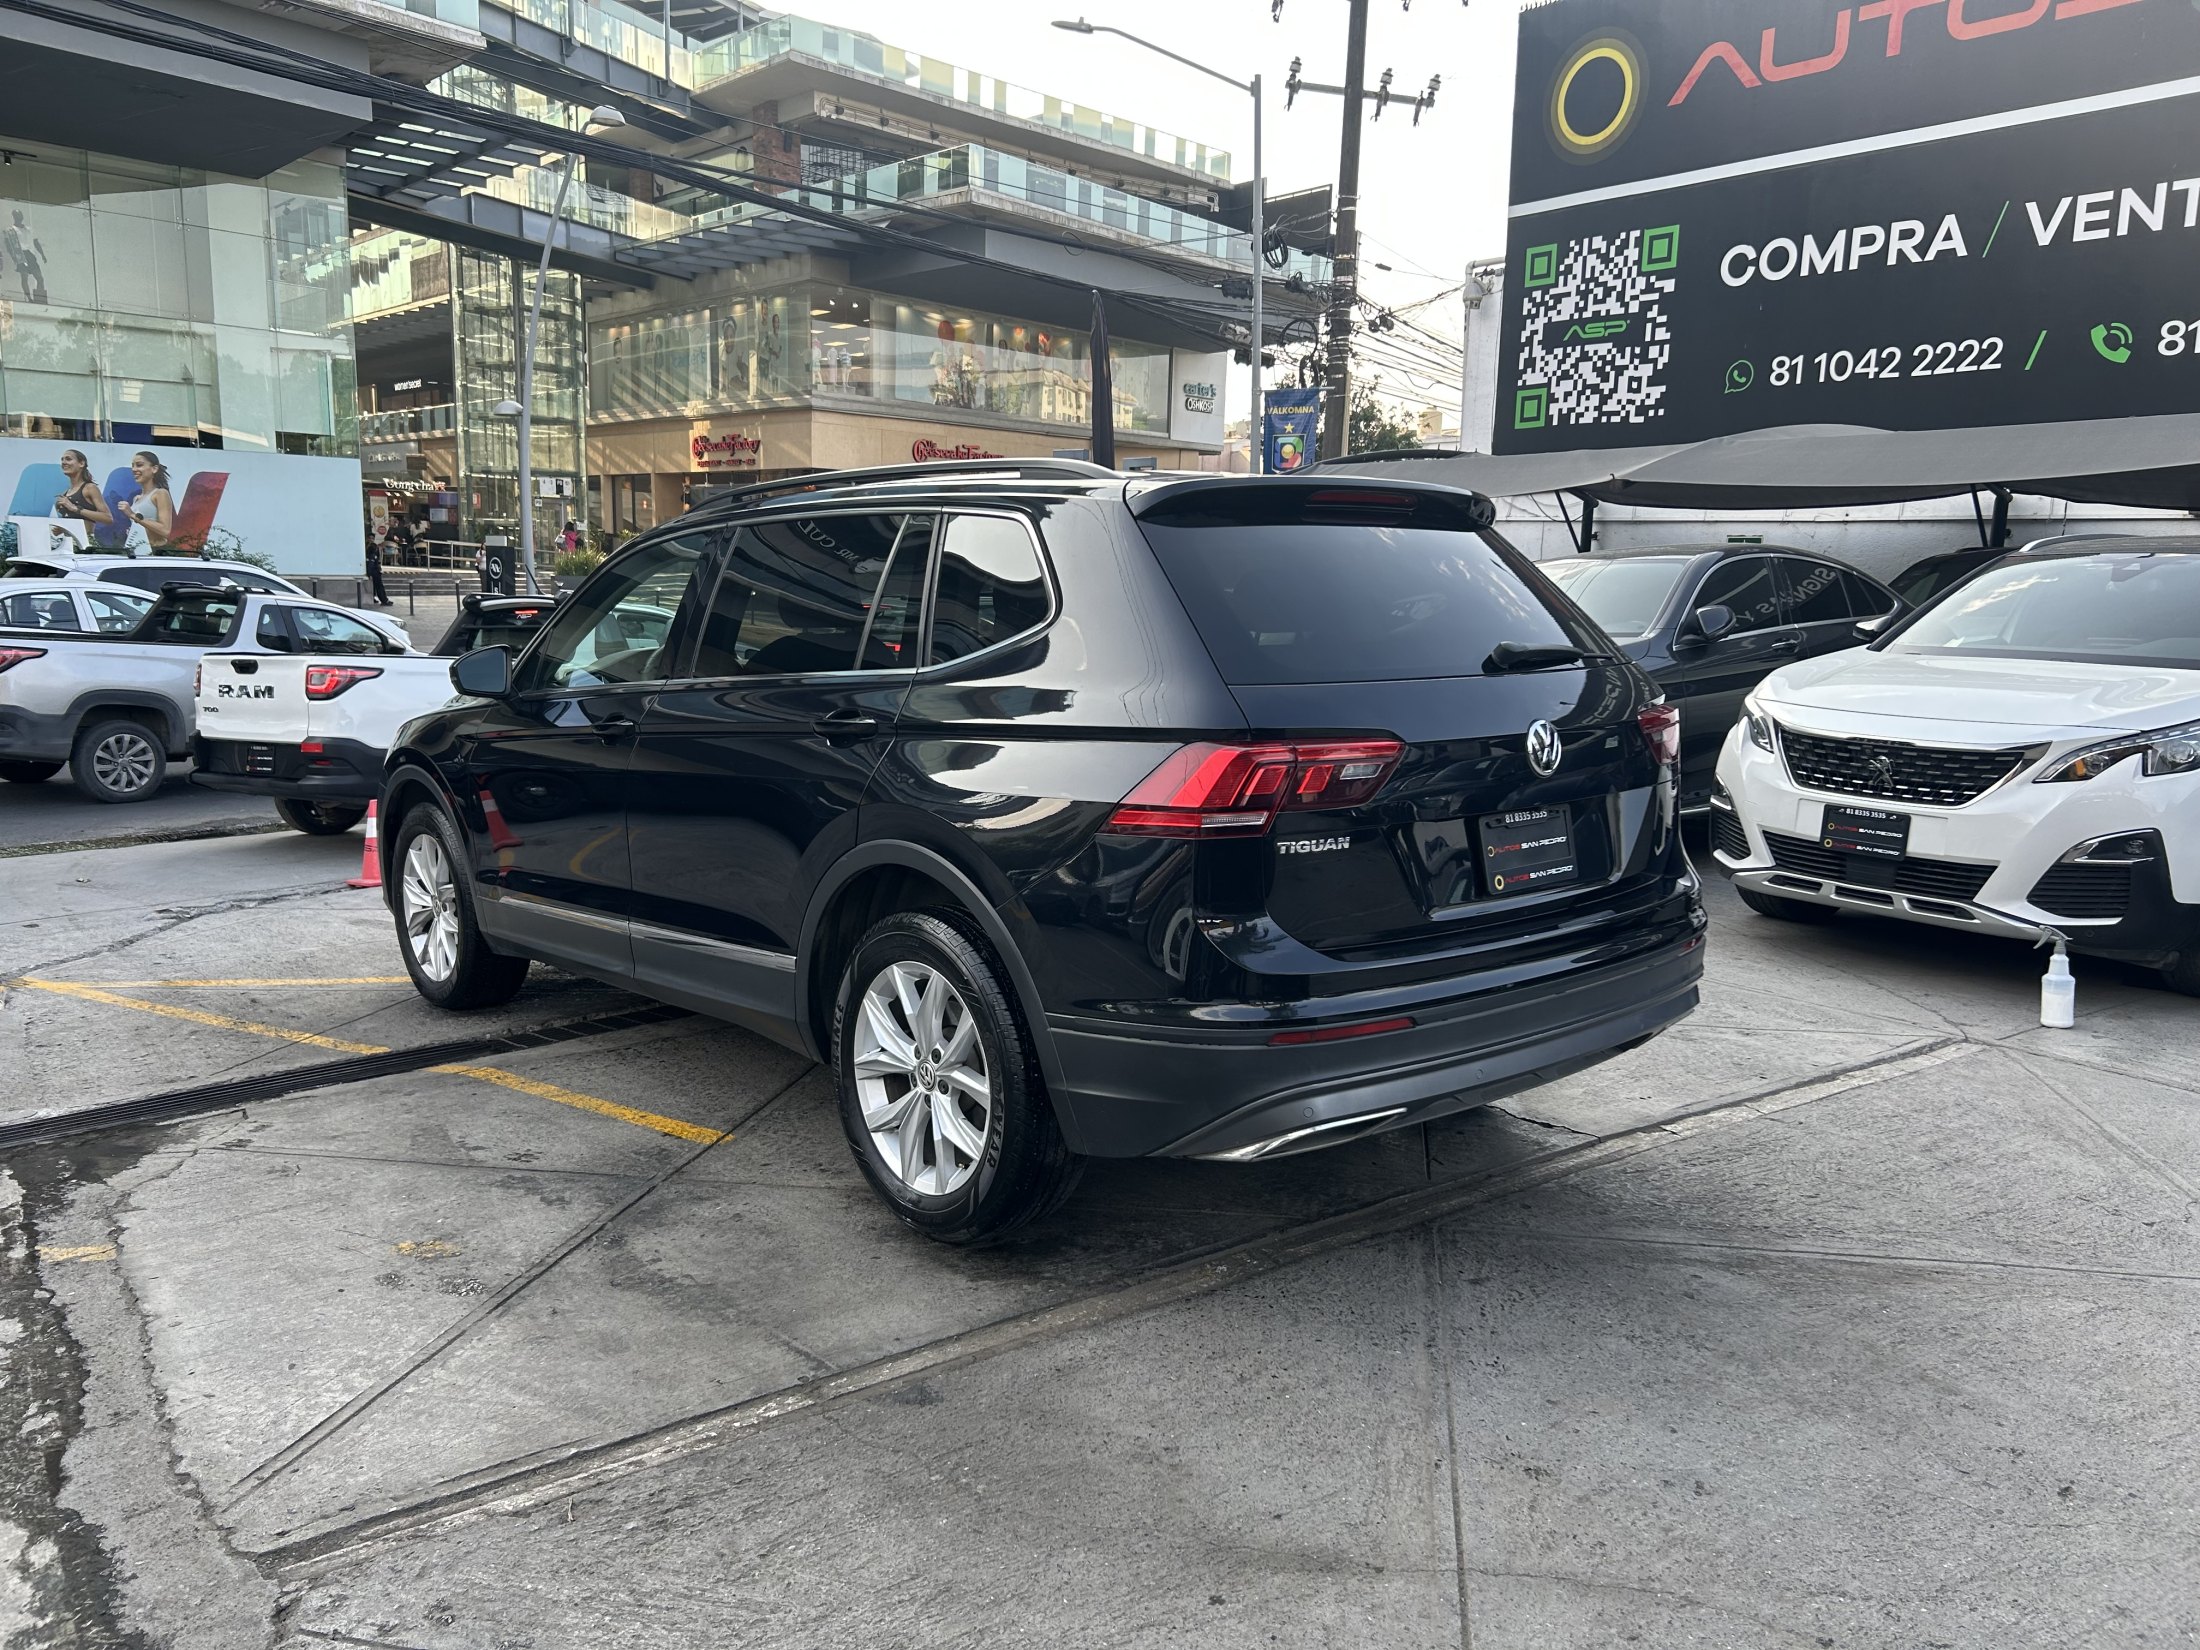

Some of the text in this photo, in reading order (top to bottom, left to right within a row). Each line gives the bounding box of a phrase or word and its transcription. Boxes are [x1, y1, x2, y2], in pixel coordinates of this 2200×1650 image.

[1667, 0, 2142, 106] AUTO
[1720, 214, 1968, 287] COMPRA
[1769, 355, 1804, 387] 81
[1813, 346, 1901, 383] 1042
[1911, 337, 2004, 377] 2222
[1183, 383, 1217, 397] carter's
[218, 684, 275, 699] RAM
[1505, 813, 1514, 823] 81
[1515, 811, 1531, 822] 8335
[1276, 836, 1350, 855] TIGUAN
[1521, 841, 1539, 850] SAN
[1529, 870, 1547, 879] SAN
